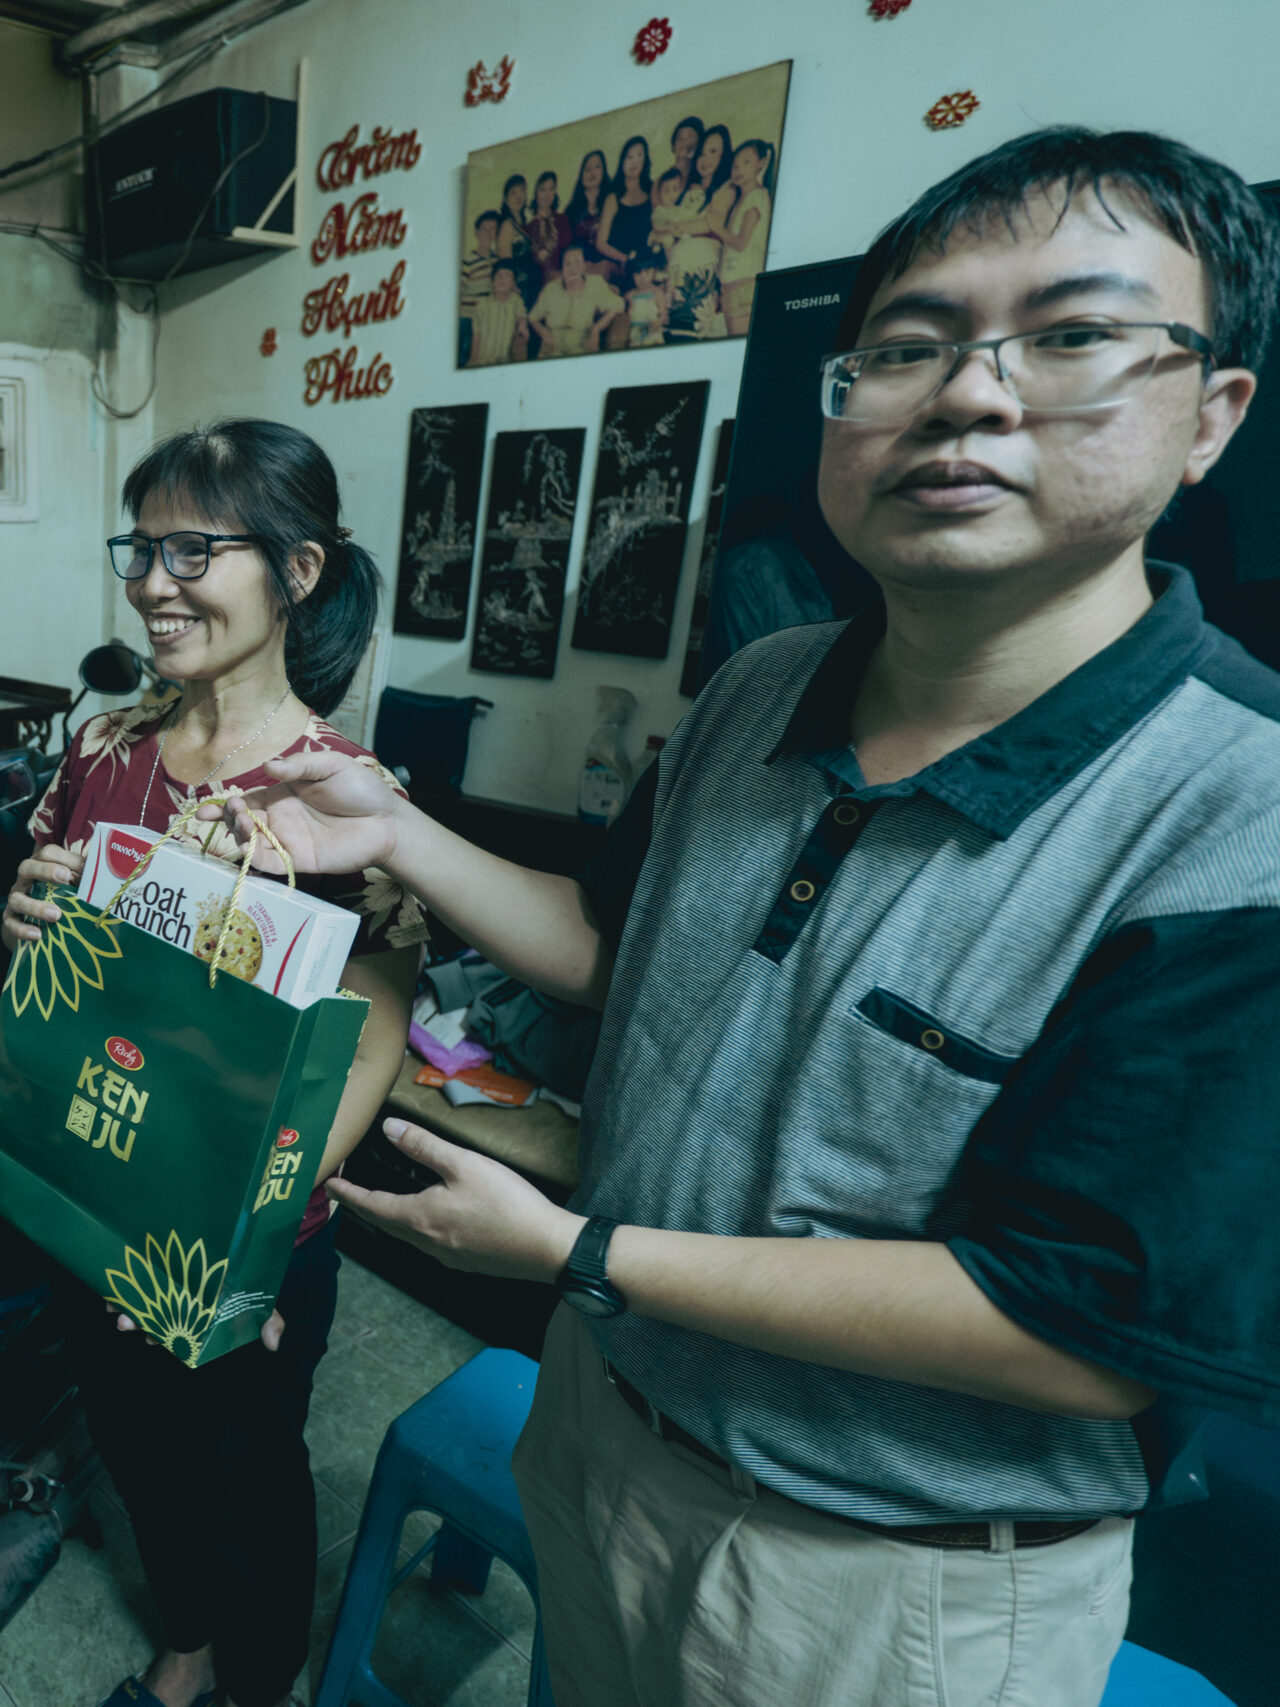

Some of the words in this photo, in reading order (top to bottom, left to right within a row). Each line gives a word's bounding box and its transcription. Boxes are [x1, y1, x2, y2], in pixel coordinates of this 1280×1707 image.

[316, 123, 421, 192] Trăm
[310, 192, 408, 266] Năm
[301, 259, 407, 338] Hạnh
[784, 293, 841, 311] TOSHIBA
[304, 345, 394, 406] Phúc
[76, 1055, 150, 1124] KEN
[91, 1111, 137, 1163] JU
